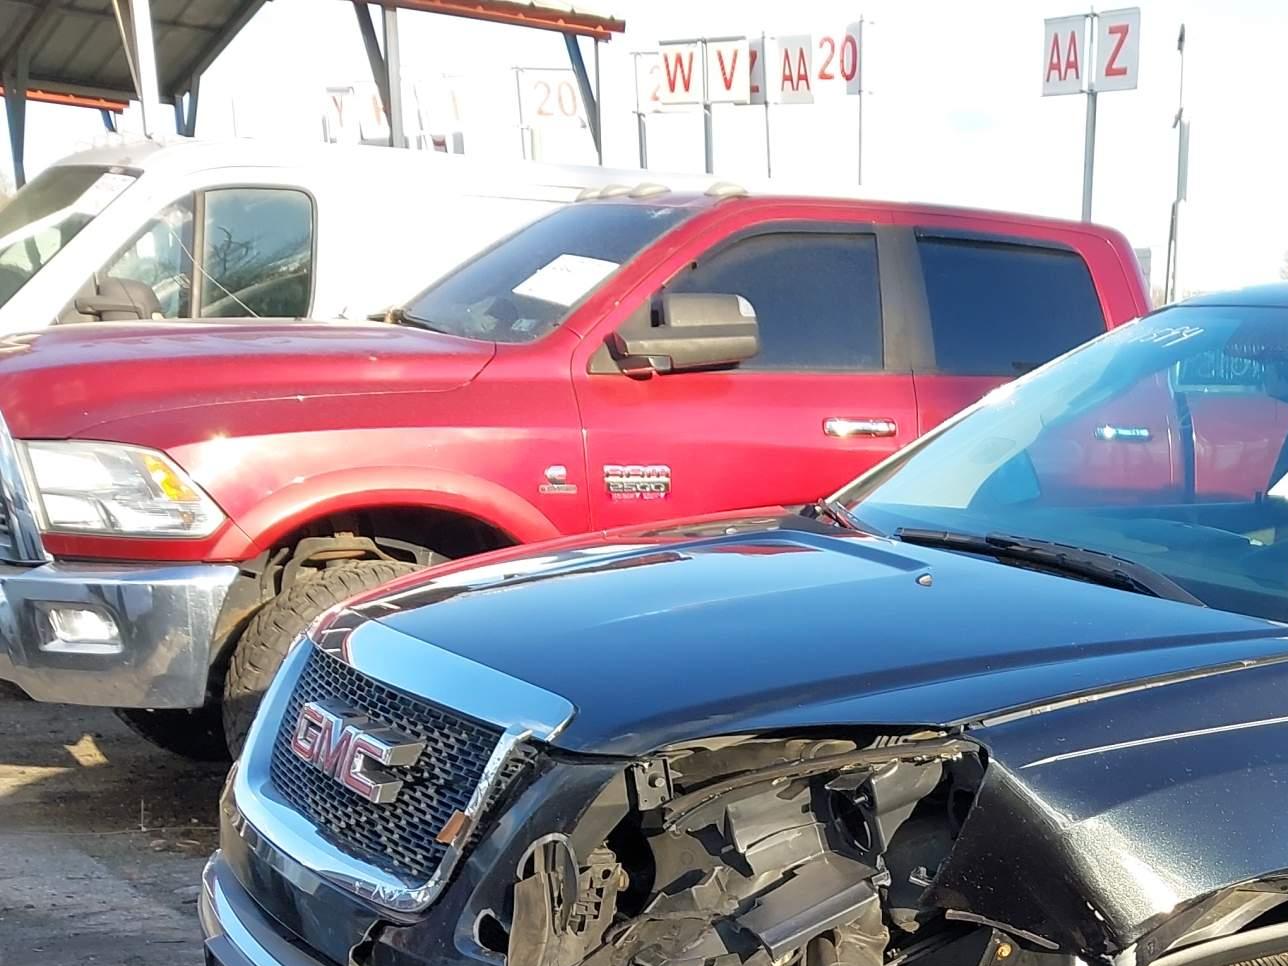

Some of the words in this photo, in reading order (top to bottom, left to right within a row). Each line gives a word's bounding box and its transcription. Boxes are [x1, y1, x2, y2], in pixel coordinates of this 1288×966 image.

[663, 52, 694, 93] W
[717, 49, 739, 91] V
[781, 47, 811, 91] AA
[818, 34, 858, 81] 20
[1046, 31, 1080, 82] AA
[1105, 24, 1129, 76] Z
[534, 80, 579, 118] 20
[291, 702, 392, 804] GMC
